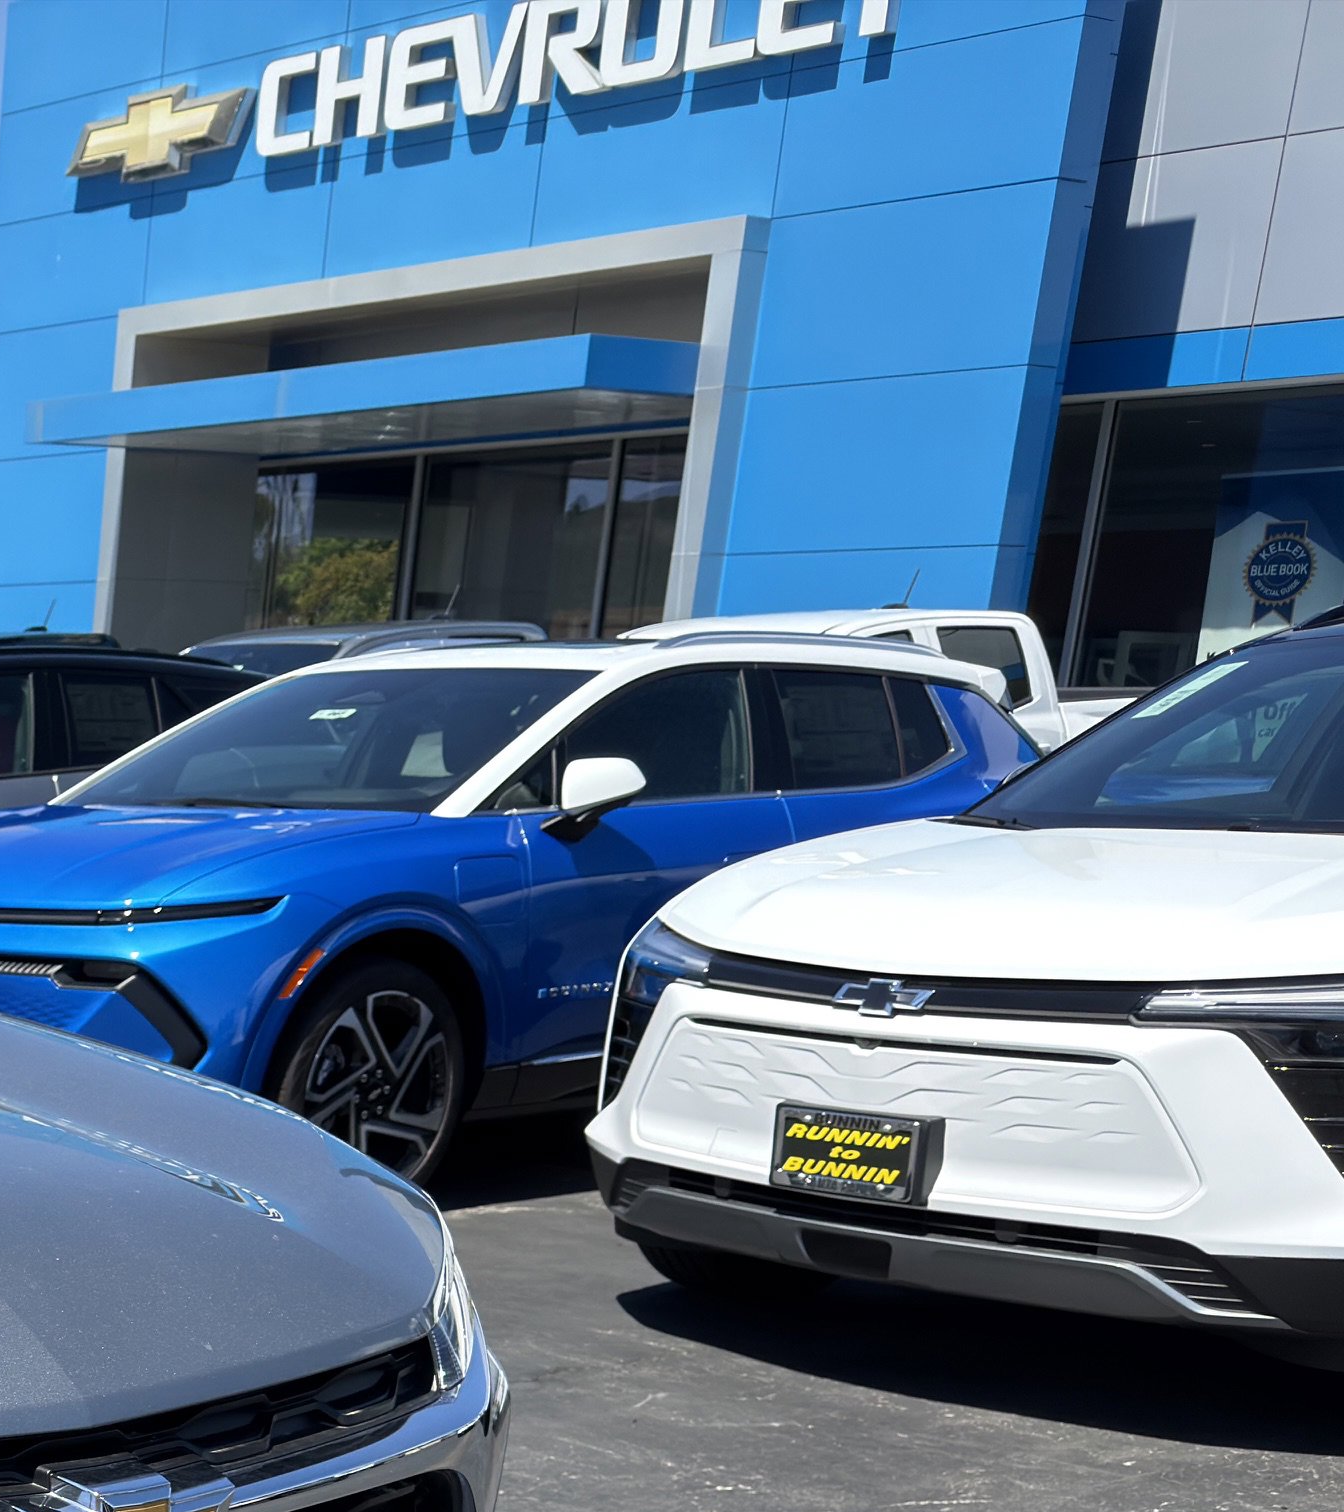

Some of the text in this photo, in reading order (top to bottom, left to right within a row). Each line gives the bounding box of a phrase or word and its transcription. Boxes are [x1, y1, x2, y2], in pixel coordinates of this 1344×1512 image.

[1259, 541, 1307, 560] KELLEY
[1250, 563, 1309, 577] BLUE BOOK
[1254, 579, 1300, 597] OFFICIAL GUIDE
[814, 1113, 882, 1131] BUNNIN
[785, 1122, 910, 1150] RUNNIN'
[829, 1145, 861, 1160] to
[782, 1156, 900, 1185] BUNNIN
